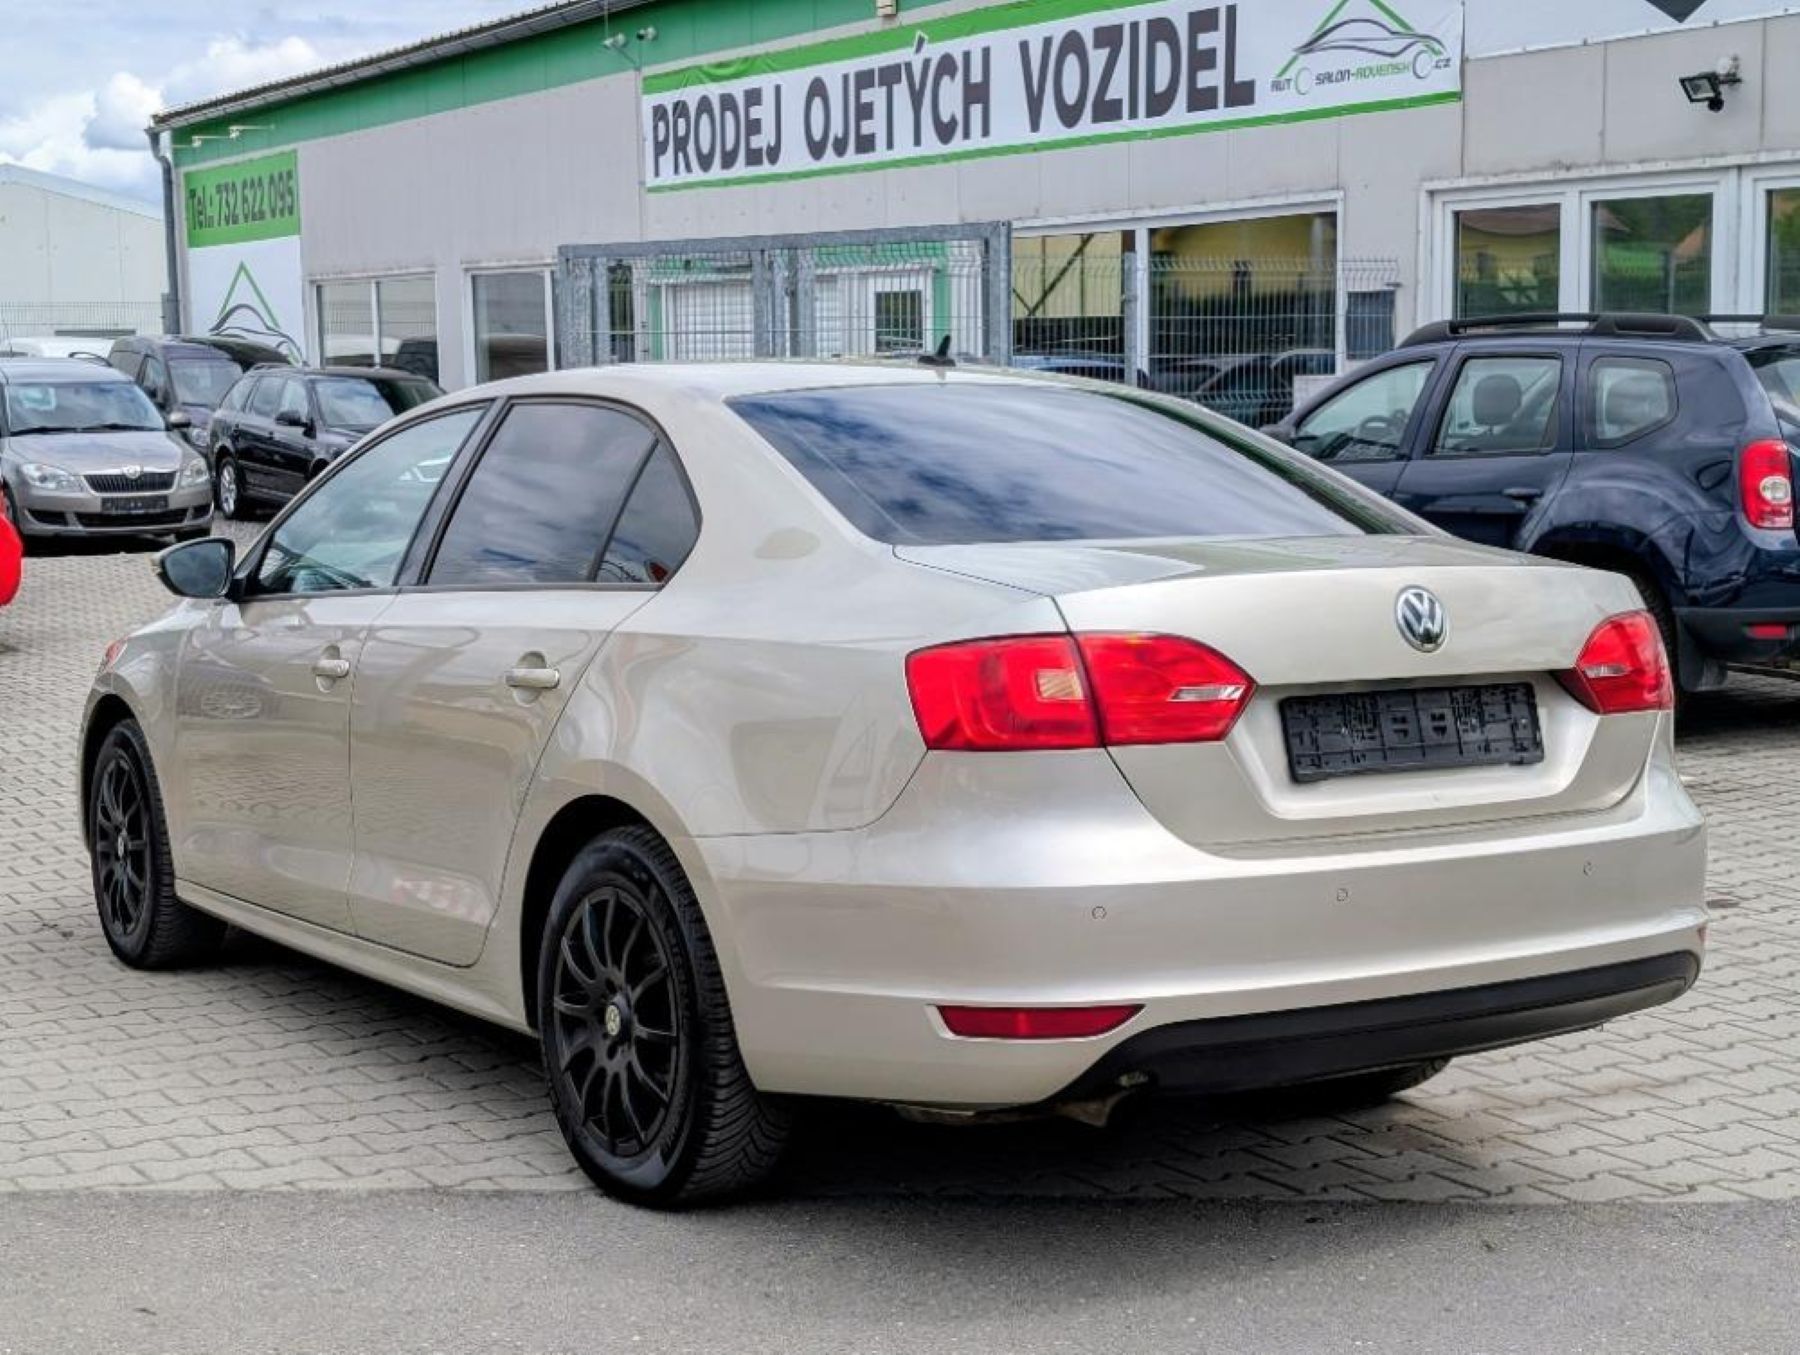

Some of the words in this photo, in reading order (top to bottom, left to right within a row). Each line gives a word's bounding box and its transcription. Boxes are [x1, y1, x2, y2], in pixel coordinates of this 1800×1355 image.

[652, 83, 782, 178] PRODEJ
[803, 34, 991, 162] OJETÝCH
[1018, 3, 1256, 134] VOZIDEL
[189, 185, 214, 231] Tel.:
[215, 181, 240, 227] 732
[242, 175, 266, 223] 622
[269, 169, 294, 219] 095
